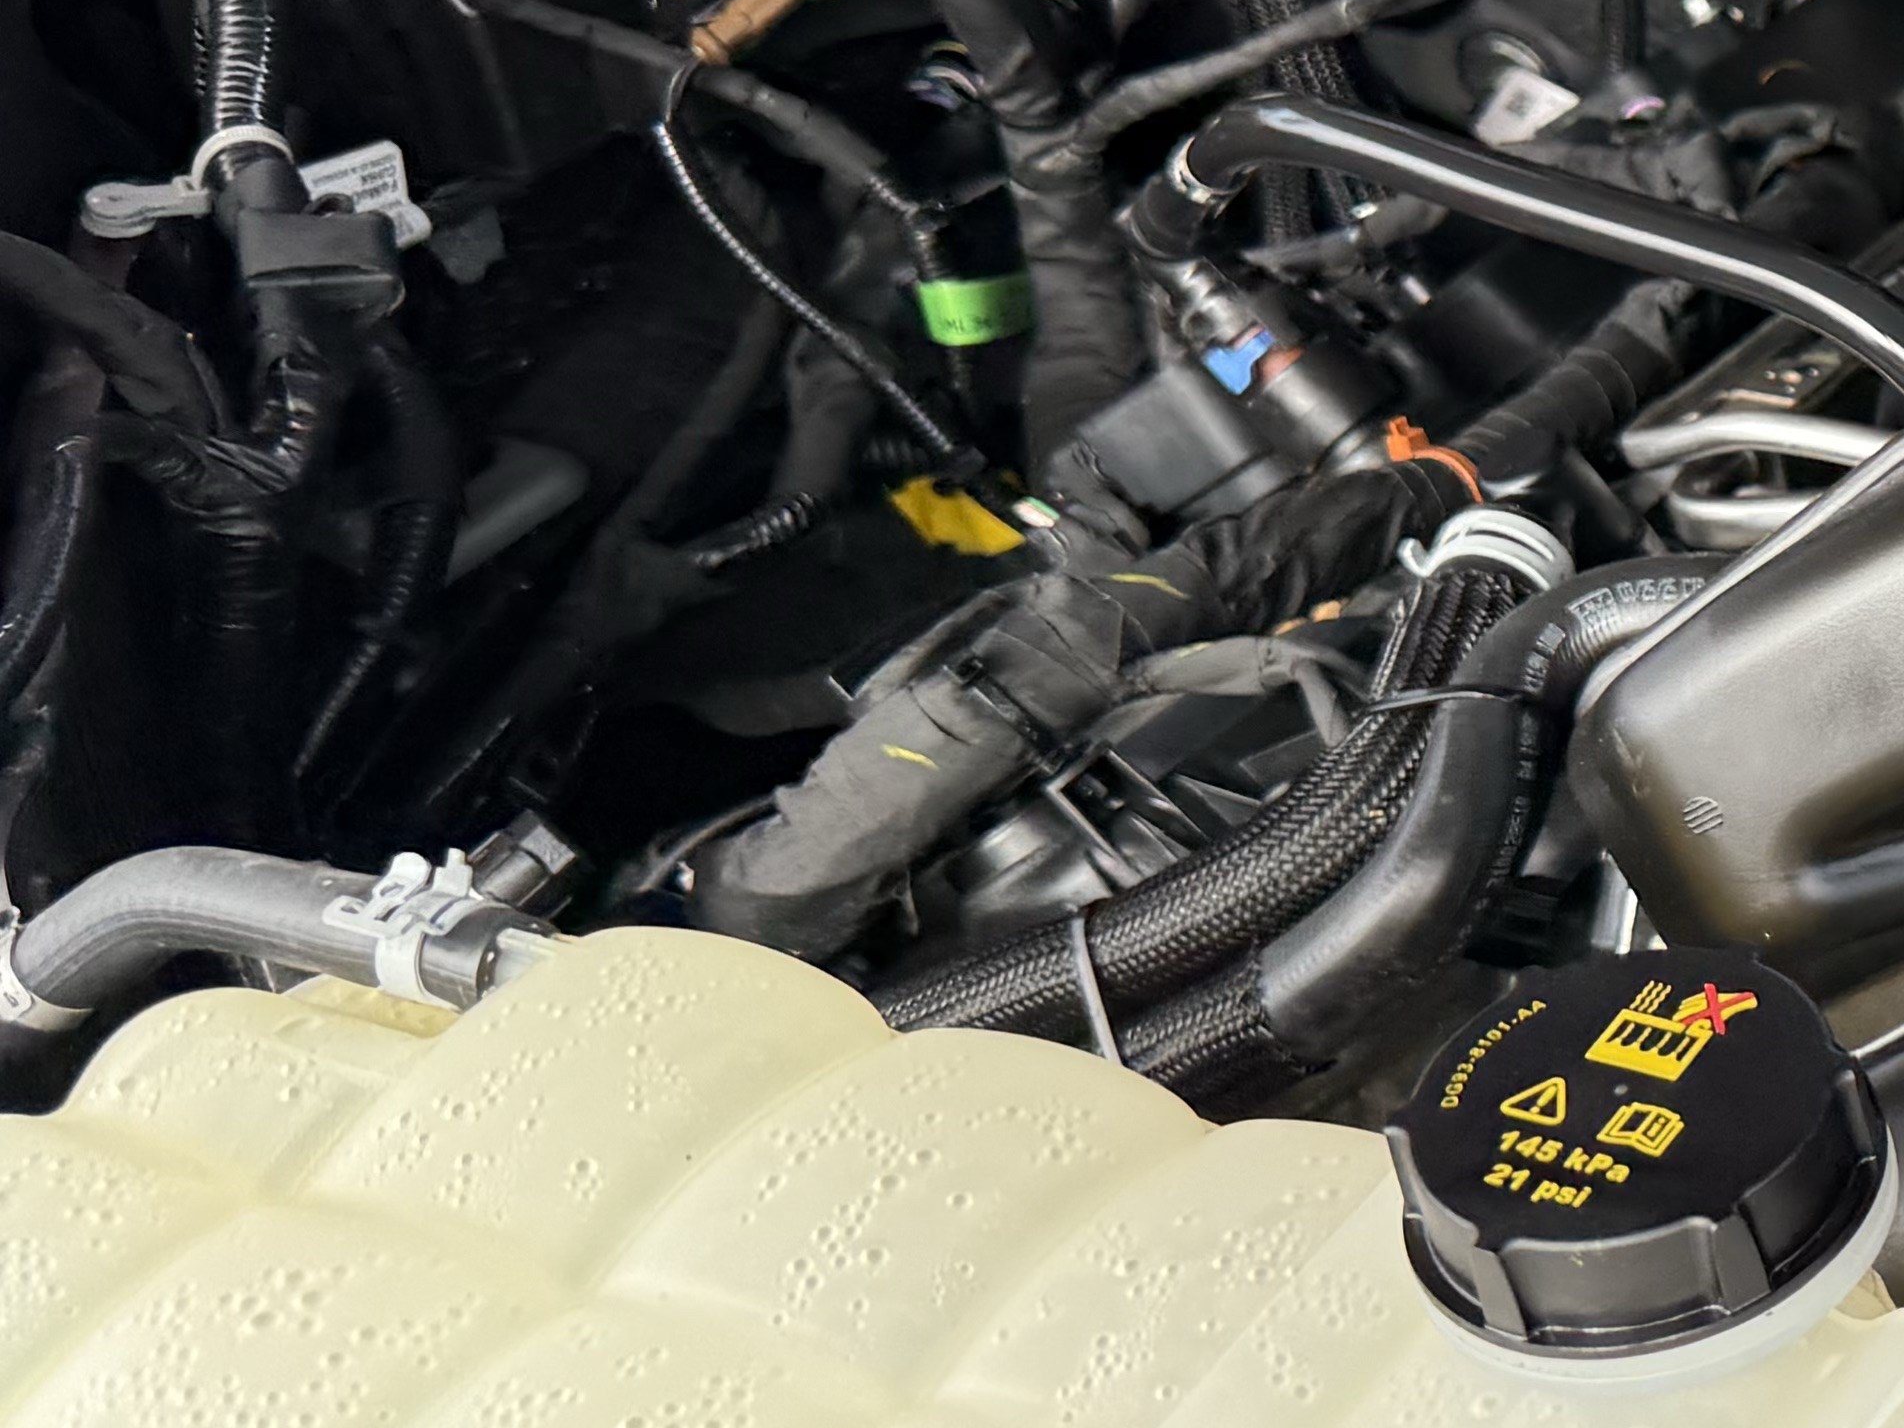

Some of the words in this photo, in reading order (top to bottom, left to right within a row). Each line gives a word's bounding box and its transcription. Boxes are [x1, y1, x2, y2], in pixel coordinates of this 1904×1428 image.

[1440, 999, 1547, 1108] DG93-8101-AA
[1499, 1130, 1564, 1164] 145
[1562, 1146, 1631, 1184] kPa
[1483, 1162, 1531, 1192] 21
[1529, 1179, 1593, 1209] psi
